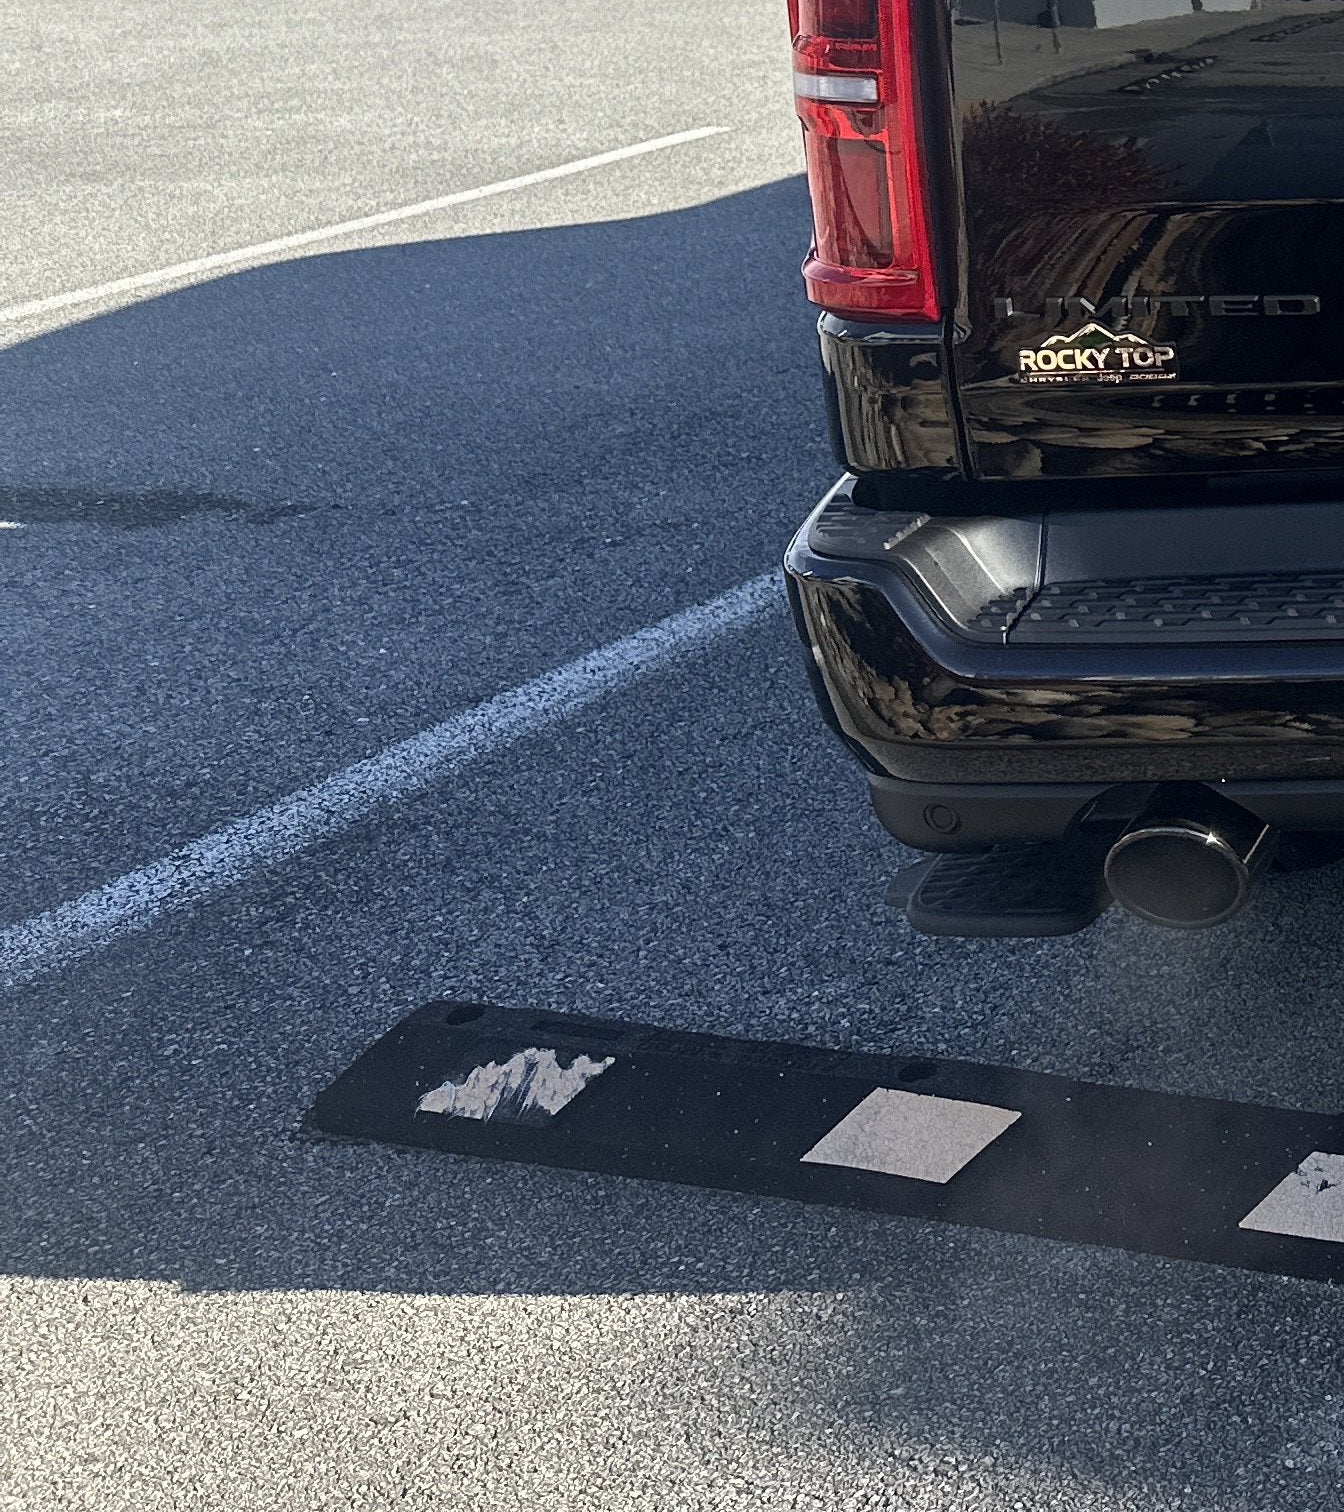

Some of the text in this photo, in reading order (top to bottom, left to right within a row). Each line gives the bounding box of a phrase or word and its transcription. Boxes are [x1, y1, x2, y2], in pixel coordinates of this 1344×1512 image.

[994, 295, 1321, 317] LIMITED
[1018, 346, 1174, 371] ROCKY TOP
